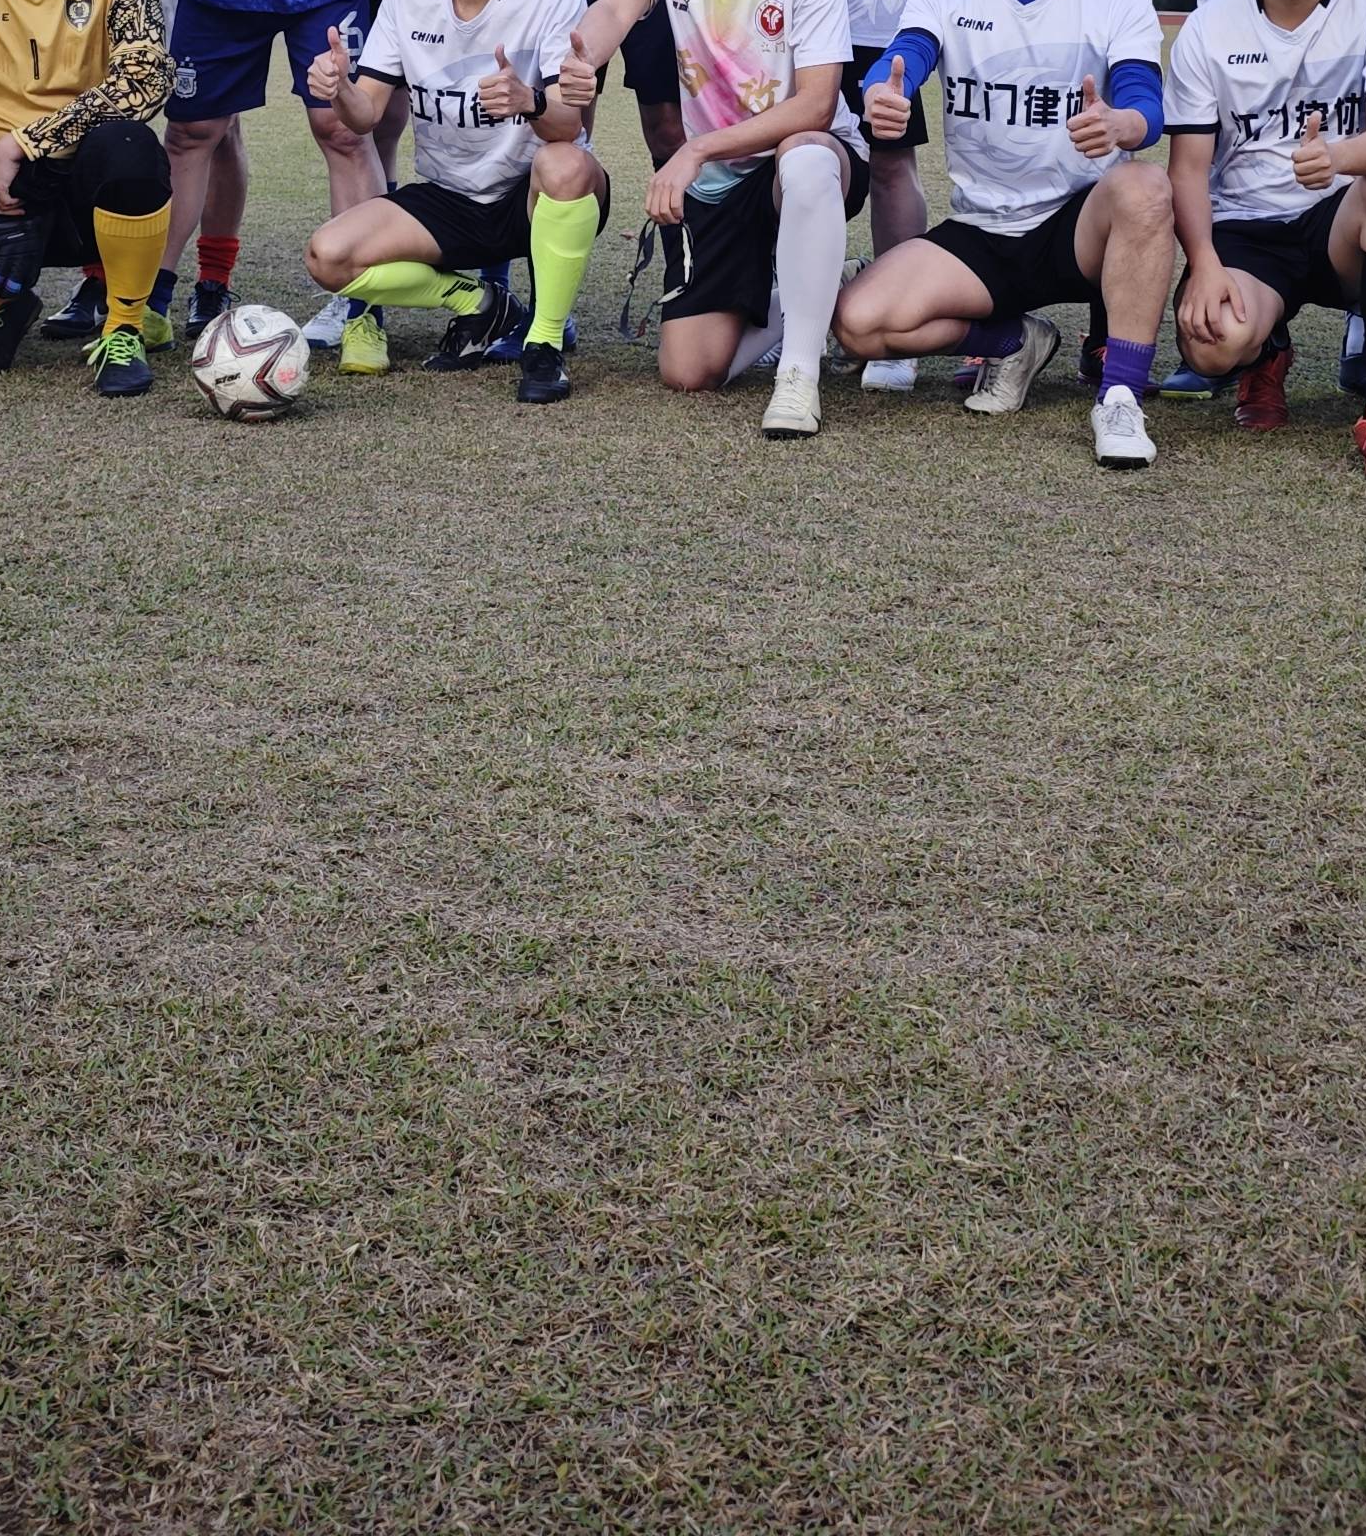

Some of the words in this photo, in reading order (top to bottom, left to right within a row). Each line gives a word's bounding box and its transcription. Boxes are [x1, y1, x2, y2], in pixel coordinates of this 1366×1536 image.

[956, 16, 994, 32] CHINA
[410, 30, 445, 44] CHINA
[29, 38, 40, 80] 1
[1227, 51, 1269, 65] CHINA
